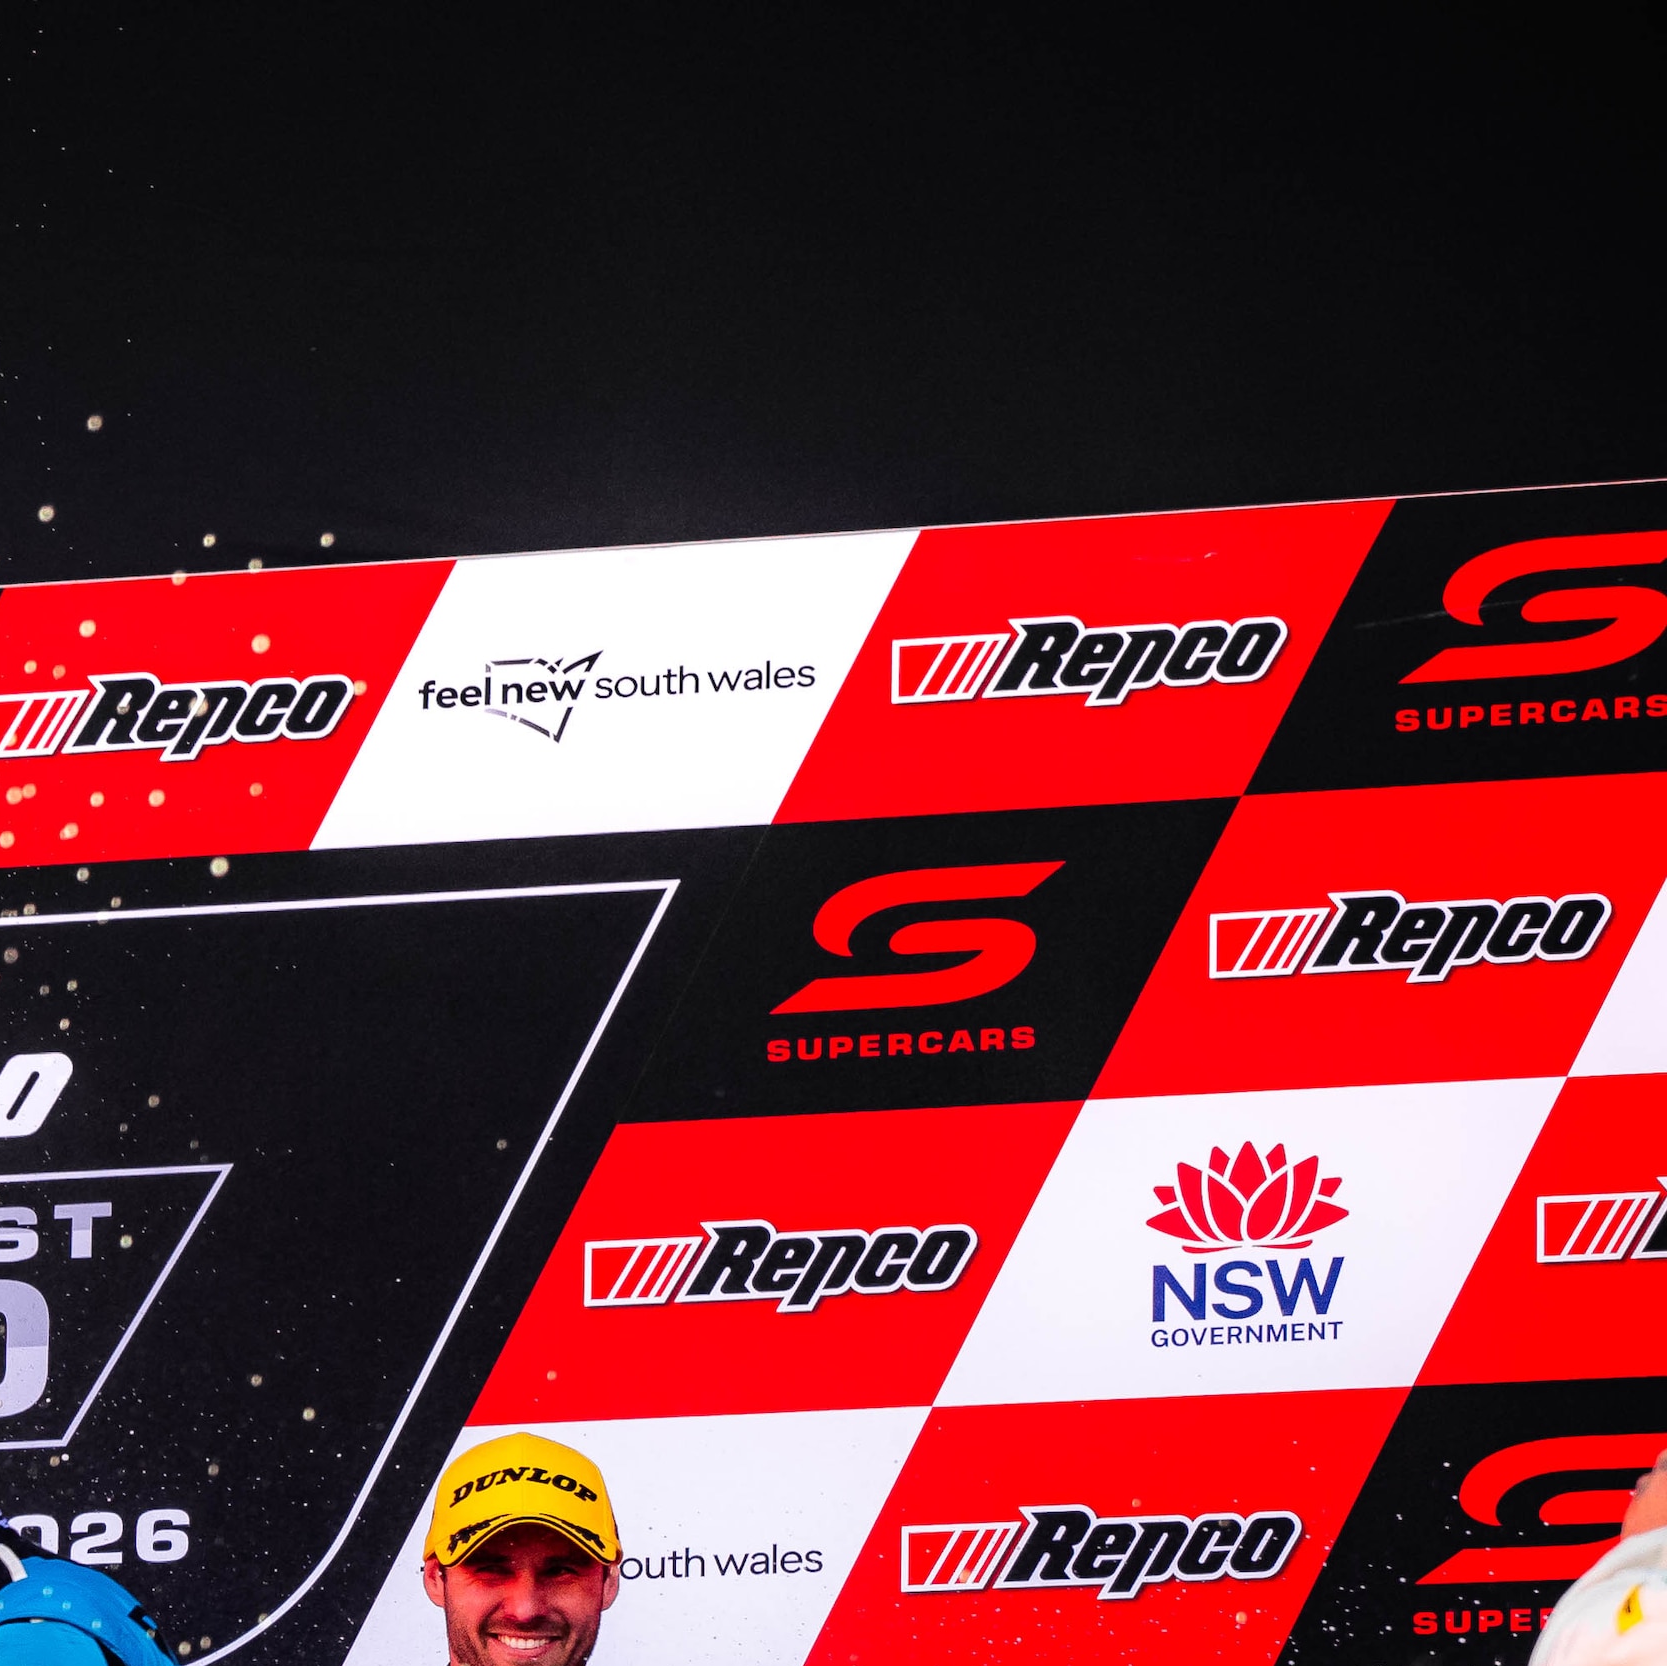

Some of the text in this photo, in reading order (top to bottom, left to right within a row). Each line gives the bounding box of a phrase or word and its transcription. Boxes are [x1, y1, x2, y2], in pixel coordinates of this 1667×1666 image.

[418, 658, 816, 711] feel new south wales
[991, 616, 1289, 706] Repco
[65, 673, 354, 762] Repco
[1395, 693, 1667, 733] SUPERCARS
[1302, 889, 1613, 983] Repco
[766, 1025, 1037, 1063] SUPERCARS
[675, 1218, 979, 1314] Repco
[1151, 1256, 1345, 1323] NSW
[1150, 1321, 1345, 1350] GOVERNMENT
[448, 1464, 599, 1509] DUNLOP
[7, 1508, 191, 1566] 026
[619, 1541, 825, 1582] outh wales
[992, 1502, 1304, 1602] Repco
